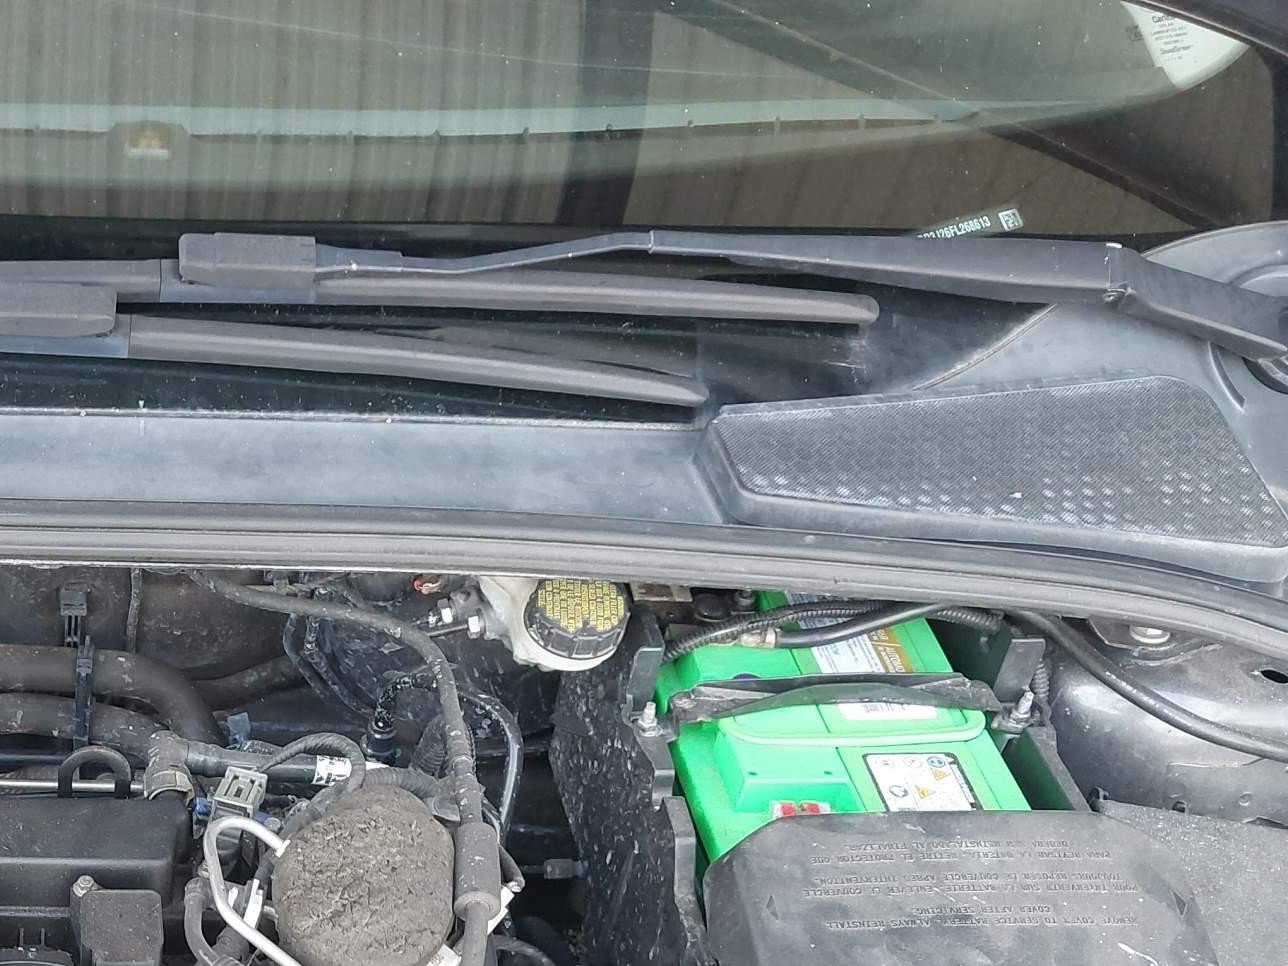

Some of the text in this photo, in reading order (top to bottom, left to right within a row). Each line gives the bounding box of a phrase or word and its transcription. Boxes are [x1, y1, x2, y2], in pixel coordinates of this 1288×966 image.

[980, 906, 1014, 914] AFTER
[1018, 905, 1051, 914] COVER
[824, 919, 886, 930] REINSTALL
[890, 918, 931, 928] ALWAYS
[994, 917, 1040, 926] SERVICE
[1044, 916, 1058, 926] TO
